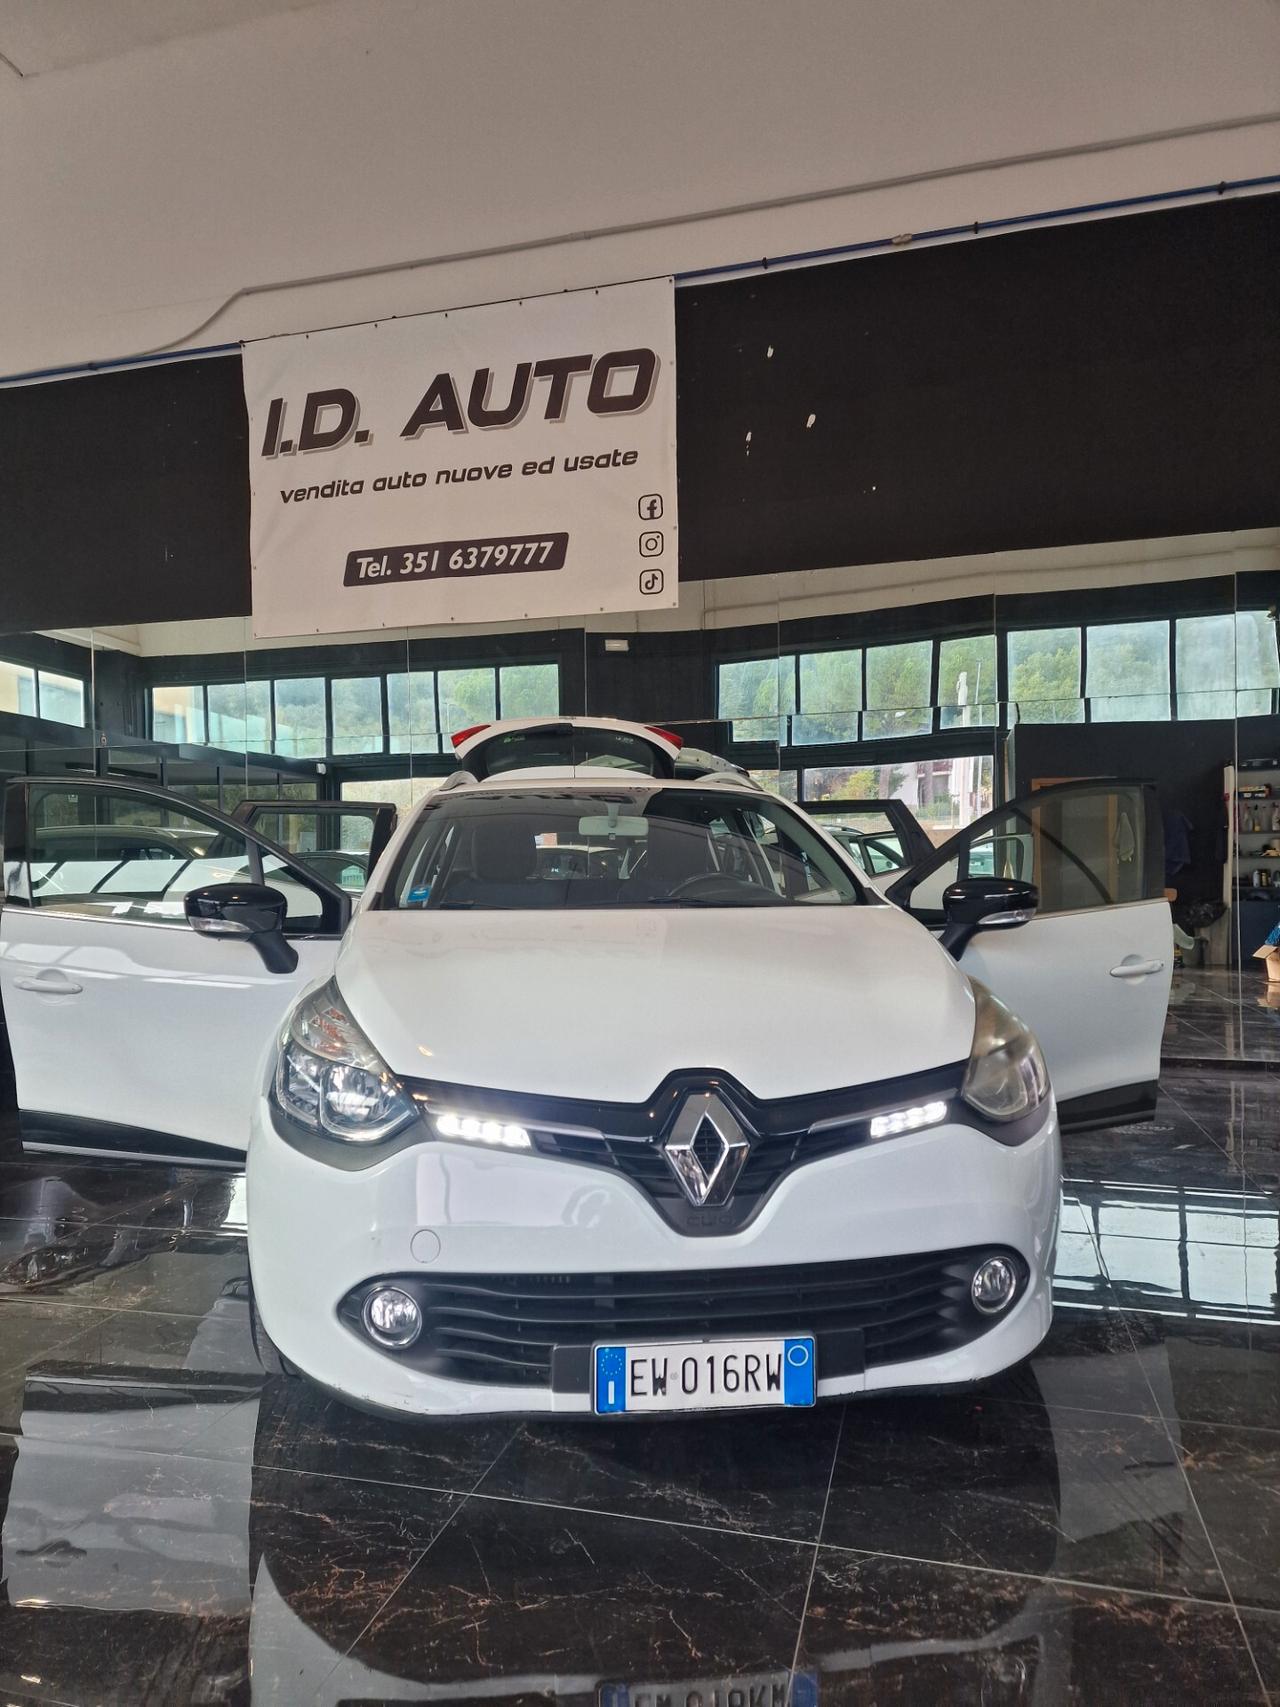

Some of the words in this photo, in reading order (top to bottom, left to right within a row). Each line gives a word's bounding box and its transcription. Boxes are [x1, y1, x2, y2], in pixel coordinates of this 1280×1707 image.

[261, 388, 374, 459] I.D.
[400, 348, 661, 441] AUTO
[280, 479, 365, 503] vendita
[372, 471, 427, 492] auto
[435, 463, 513, 485] nuove
[521, 456, 555, 476] ed
[563, 449, 639, 473] usate
[356, 555, 392, 579] Tel.
[400, 550, 440, 575] 351
[449, 541, 554, 571] 6379777
